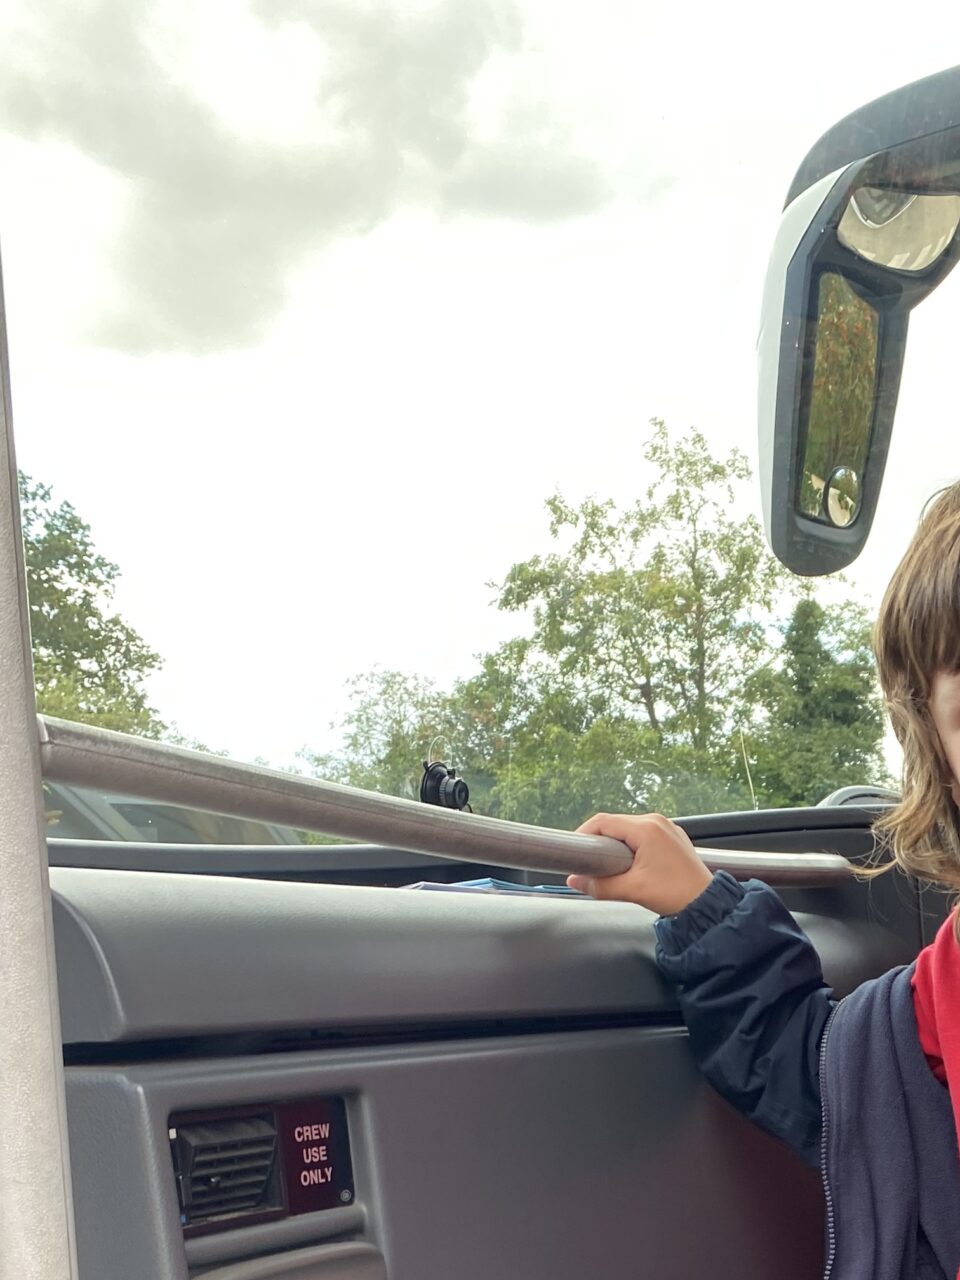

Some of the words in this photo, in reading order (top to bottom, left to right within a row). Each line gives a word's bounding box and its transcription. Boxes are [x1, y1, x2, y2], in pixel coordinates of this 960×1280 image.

[294, 1123, 330, 1142] CREW
[303, 1145, 327, 1163] USE
[300, 1166, 332, 1186] ONLY
